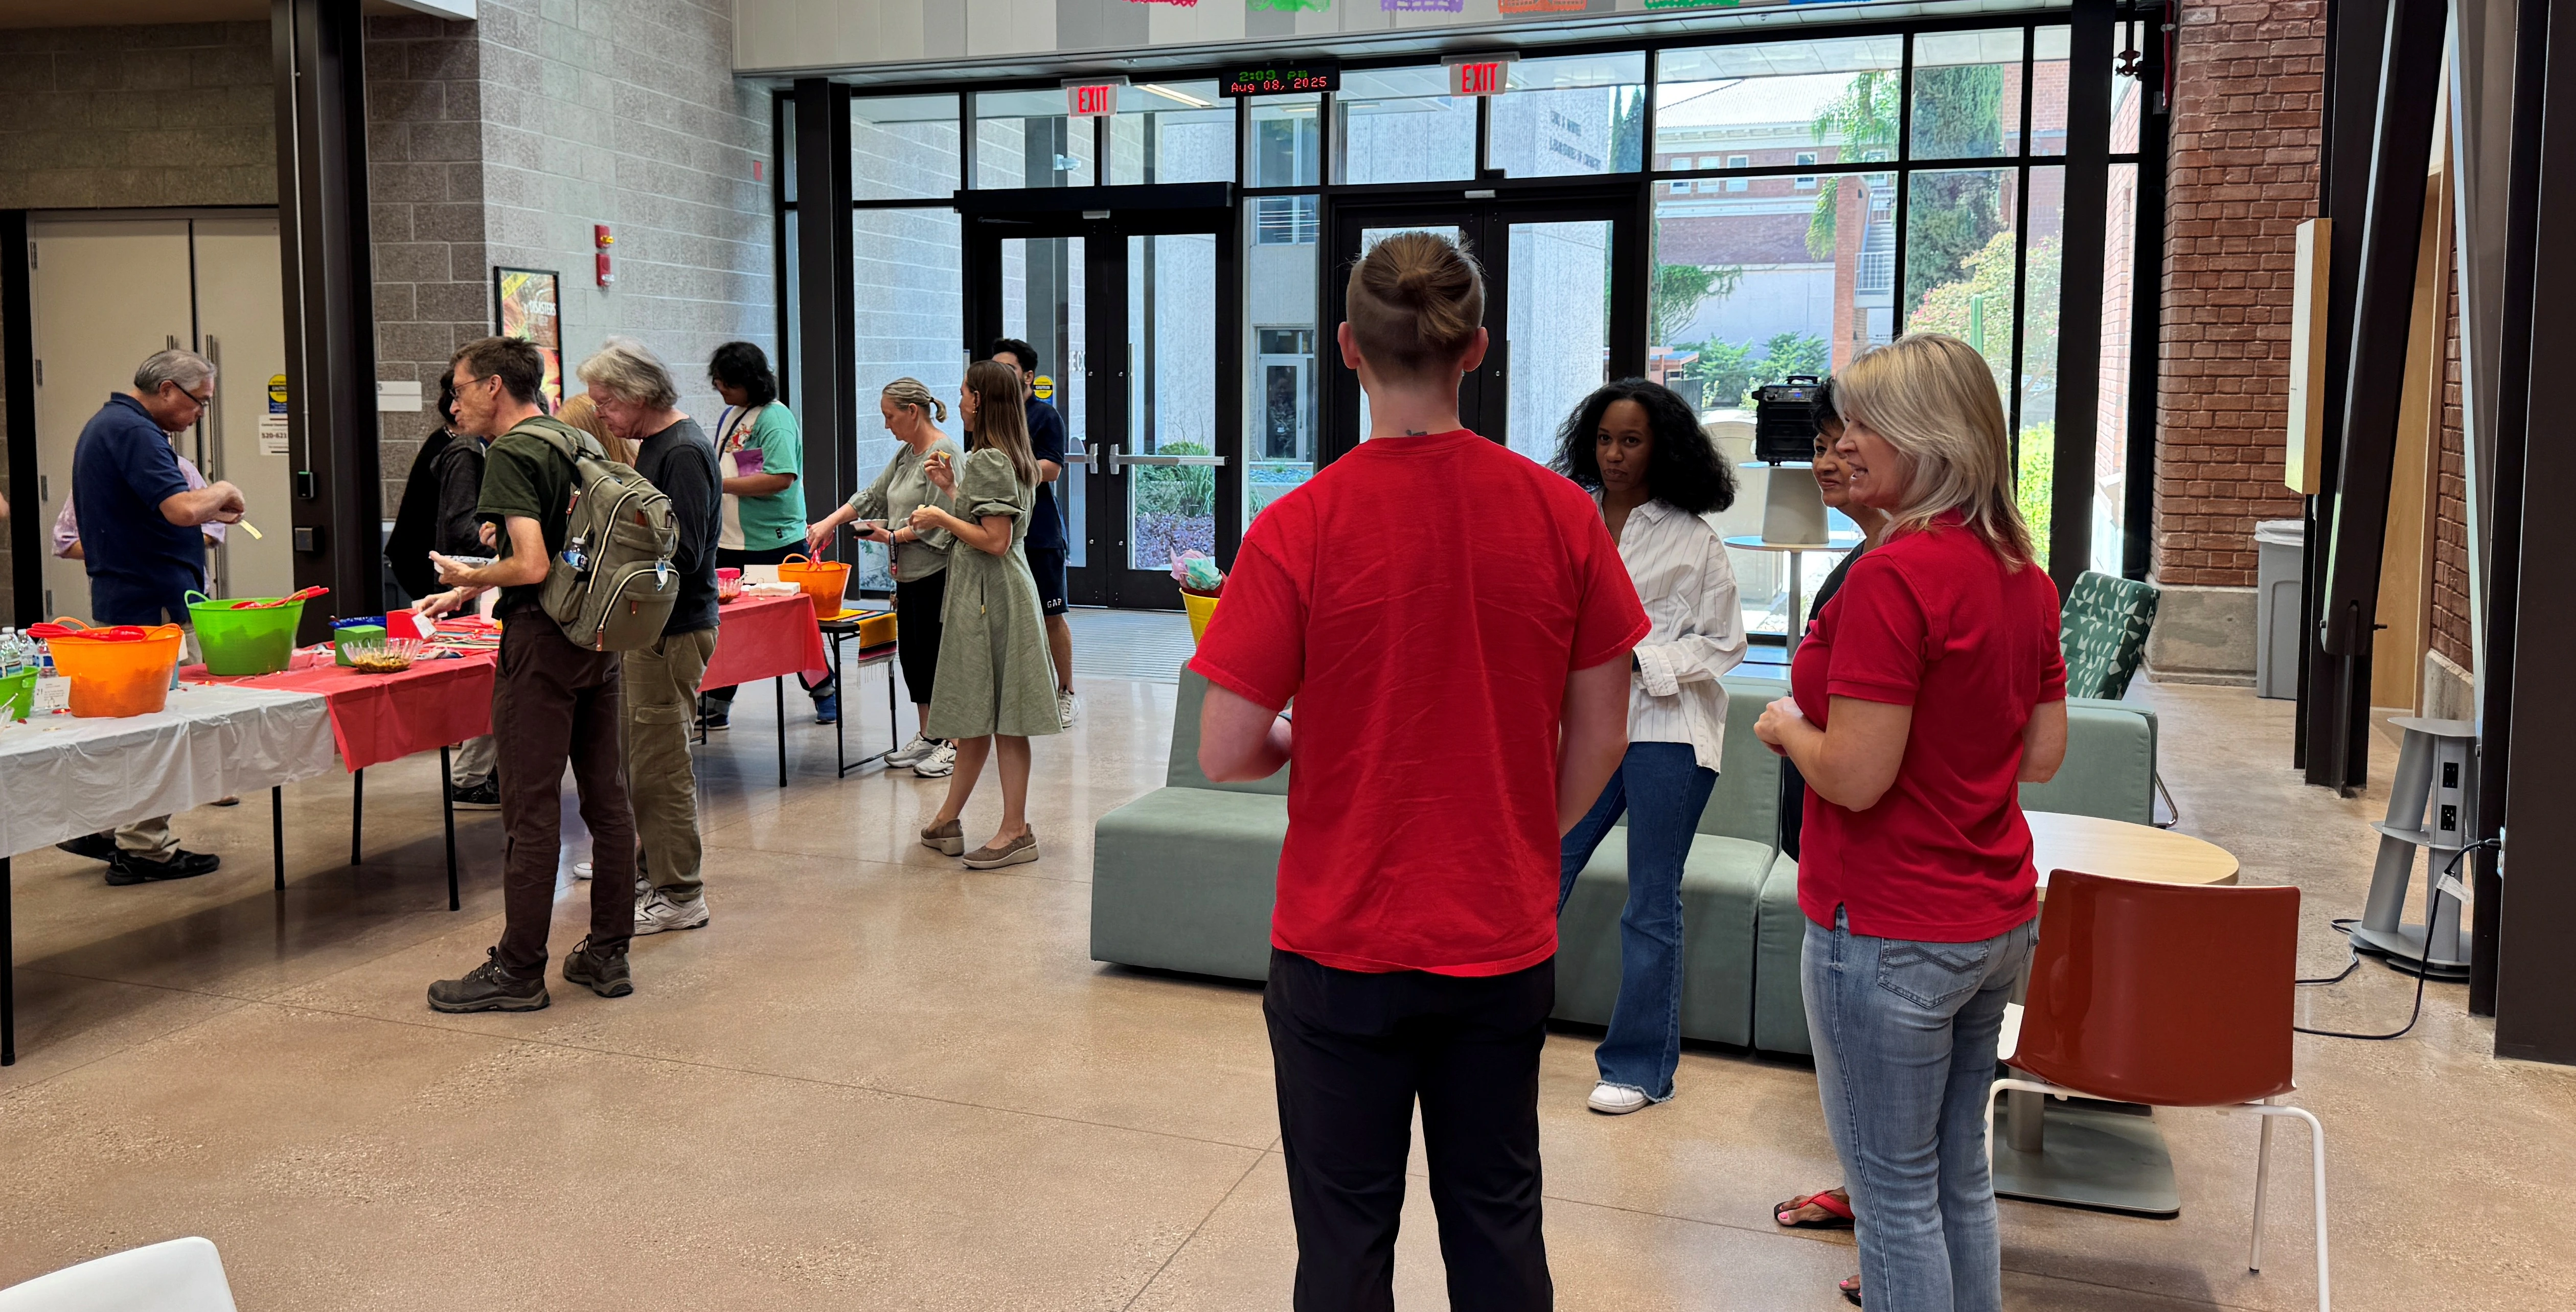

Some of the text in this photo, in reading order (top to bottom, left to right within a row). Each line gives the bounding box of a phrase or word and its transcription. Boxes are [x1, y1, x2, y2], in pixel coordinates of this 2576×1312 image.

[1231, 76, 1327, 93] Aug 08, 2025
[1462, 62, 1498, 93] EXIT
[1078, 86, 1109, 113] EXIT
[1047, 598, 1062, 608] GAP
